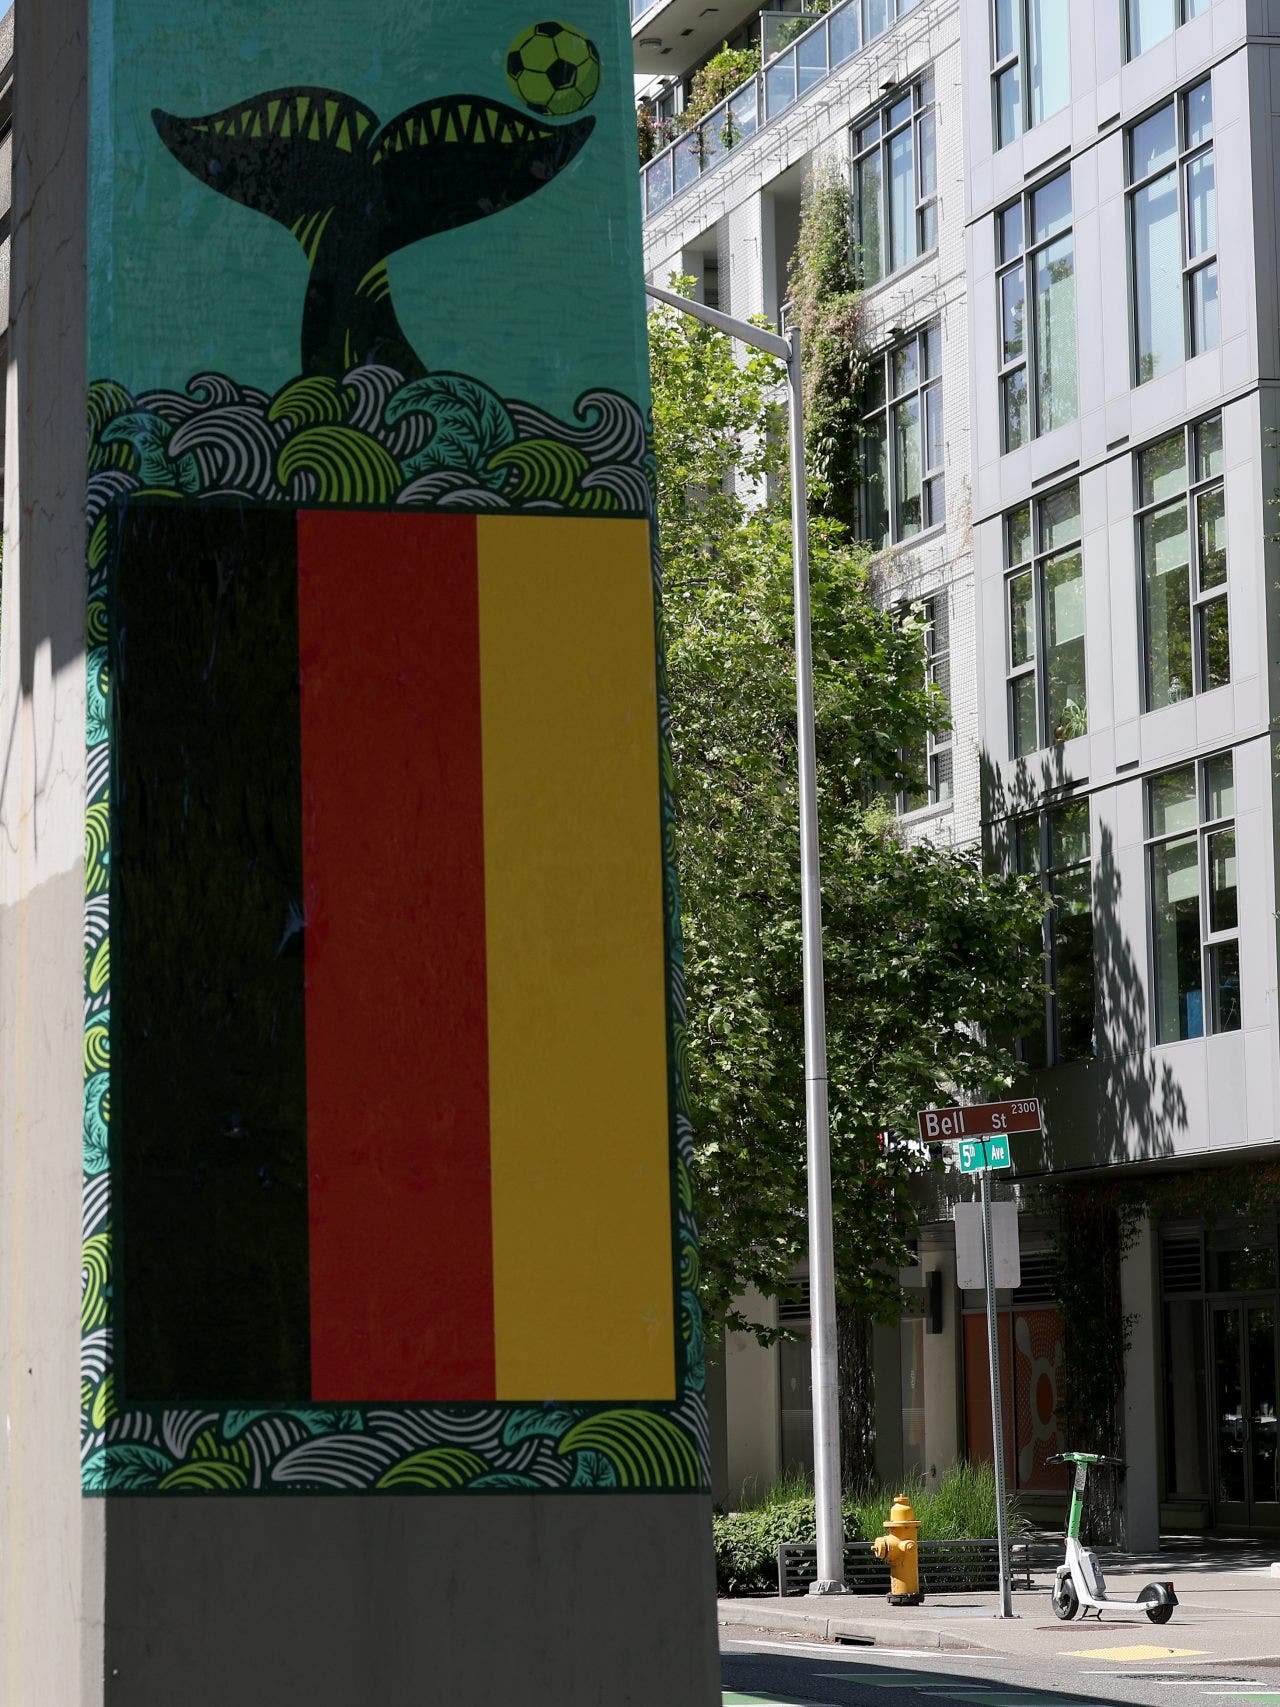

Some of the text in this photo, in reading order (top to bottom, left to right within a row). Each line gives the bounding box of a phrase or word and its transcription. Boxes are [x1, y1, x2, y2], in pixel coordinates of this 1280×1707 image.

[925, 1101, 1036, 1137] Bell St 2300
[962, 1144, 1005, 1168] 5th Ave
